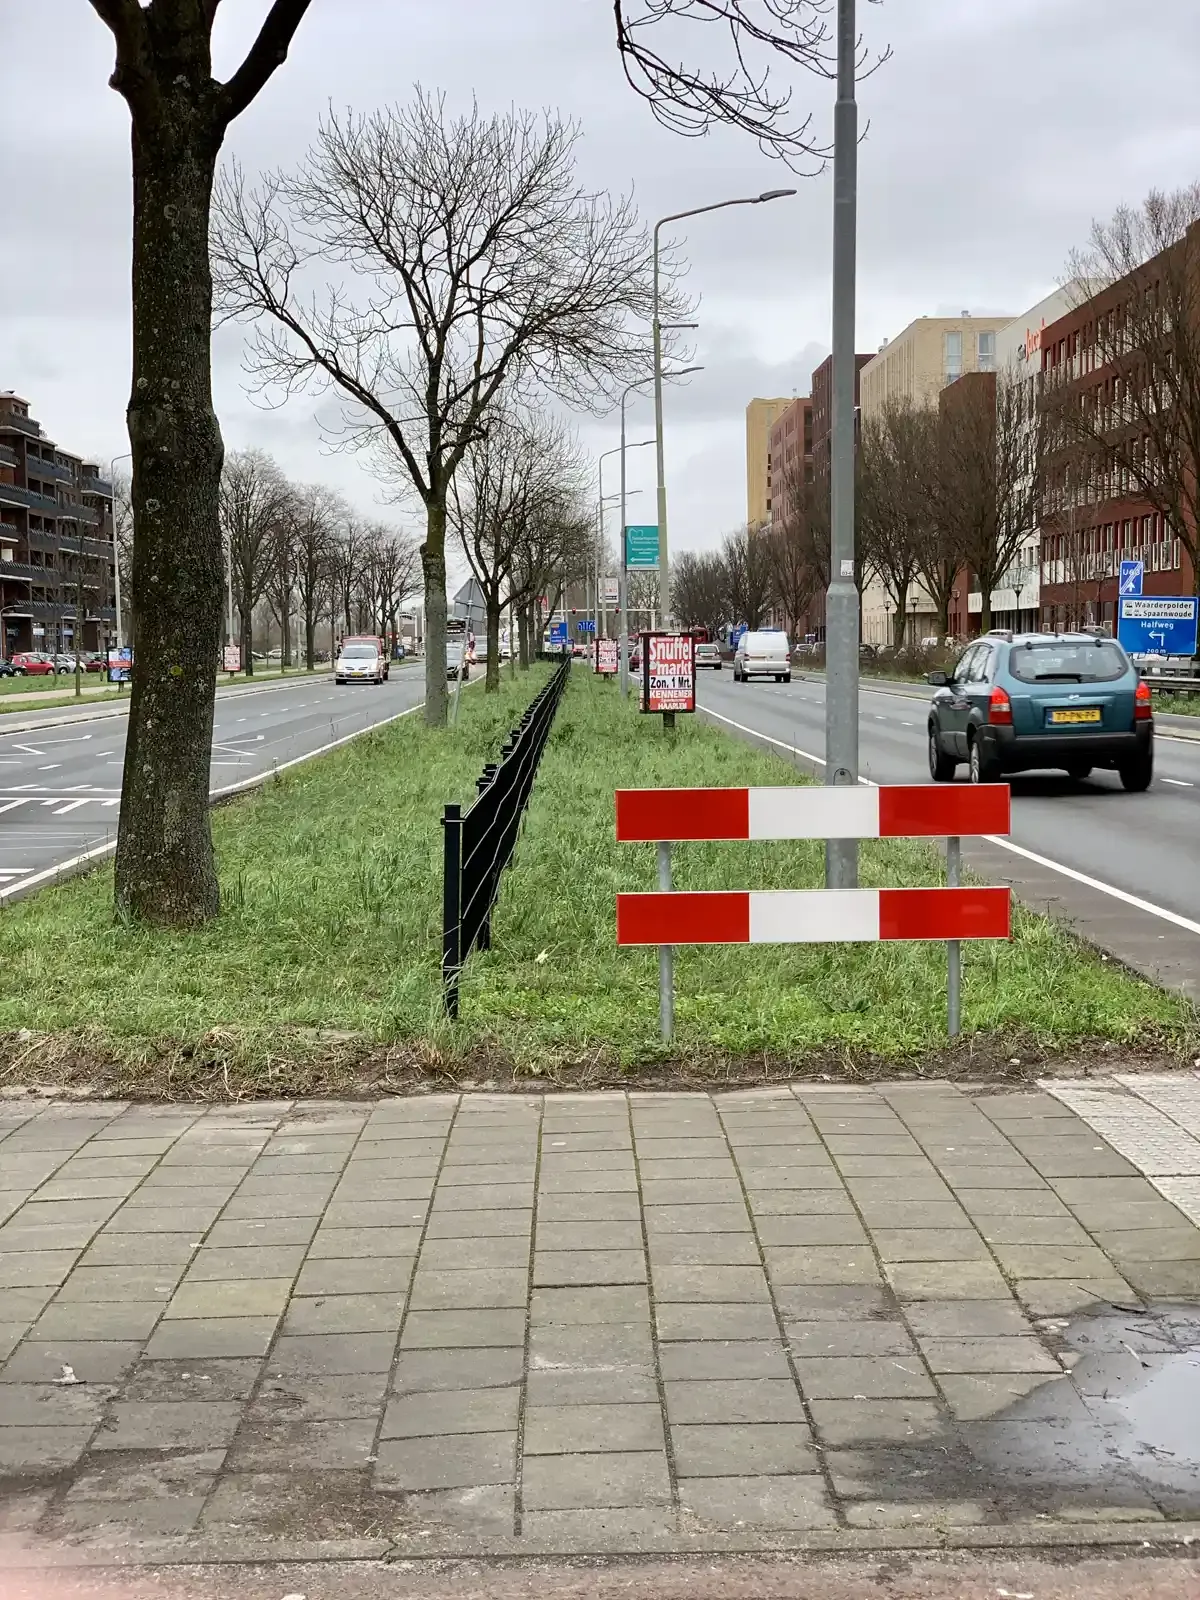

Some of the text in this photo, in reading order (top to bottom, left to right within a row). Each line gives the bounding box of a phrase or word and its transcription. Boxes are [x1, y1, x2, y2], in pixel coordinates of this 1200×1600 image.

[1134, 601, 1192, 611] Waarderpolder
[1143, 610, 1192, 618] Spaarnwoude
[1140, 621, 1174, 630] Halfweg
[649, 637, 692, 660] Snuffel
[657, 660, 692, 675] markt
[650, 677, 692, 688] Zon. 1 Mrt.
[649, 689, 693, 699] KENNEMER
